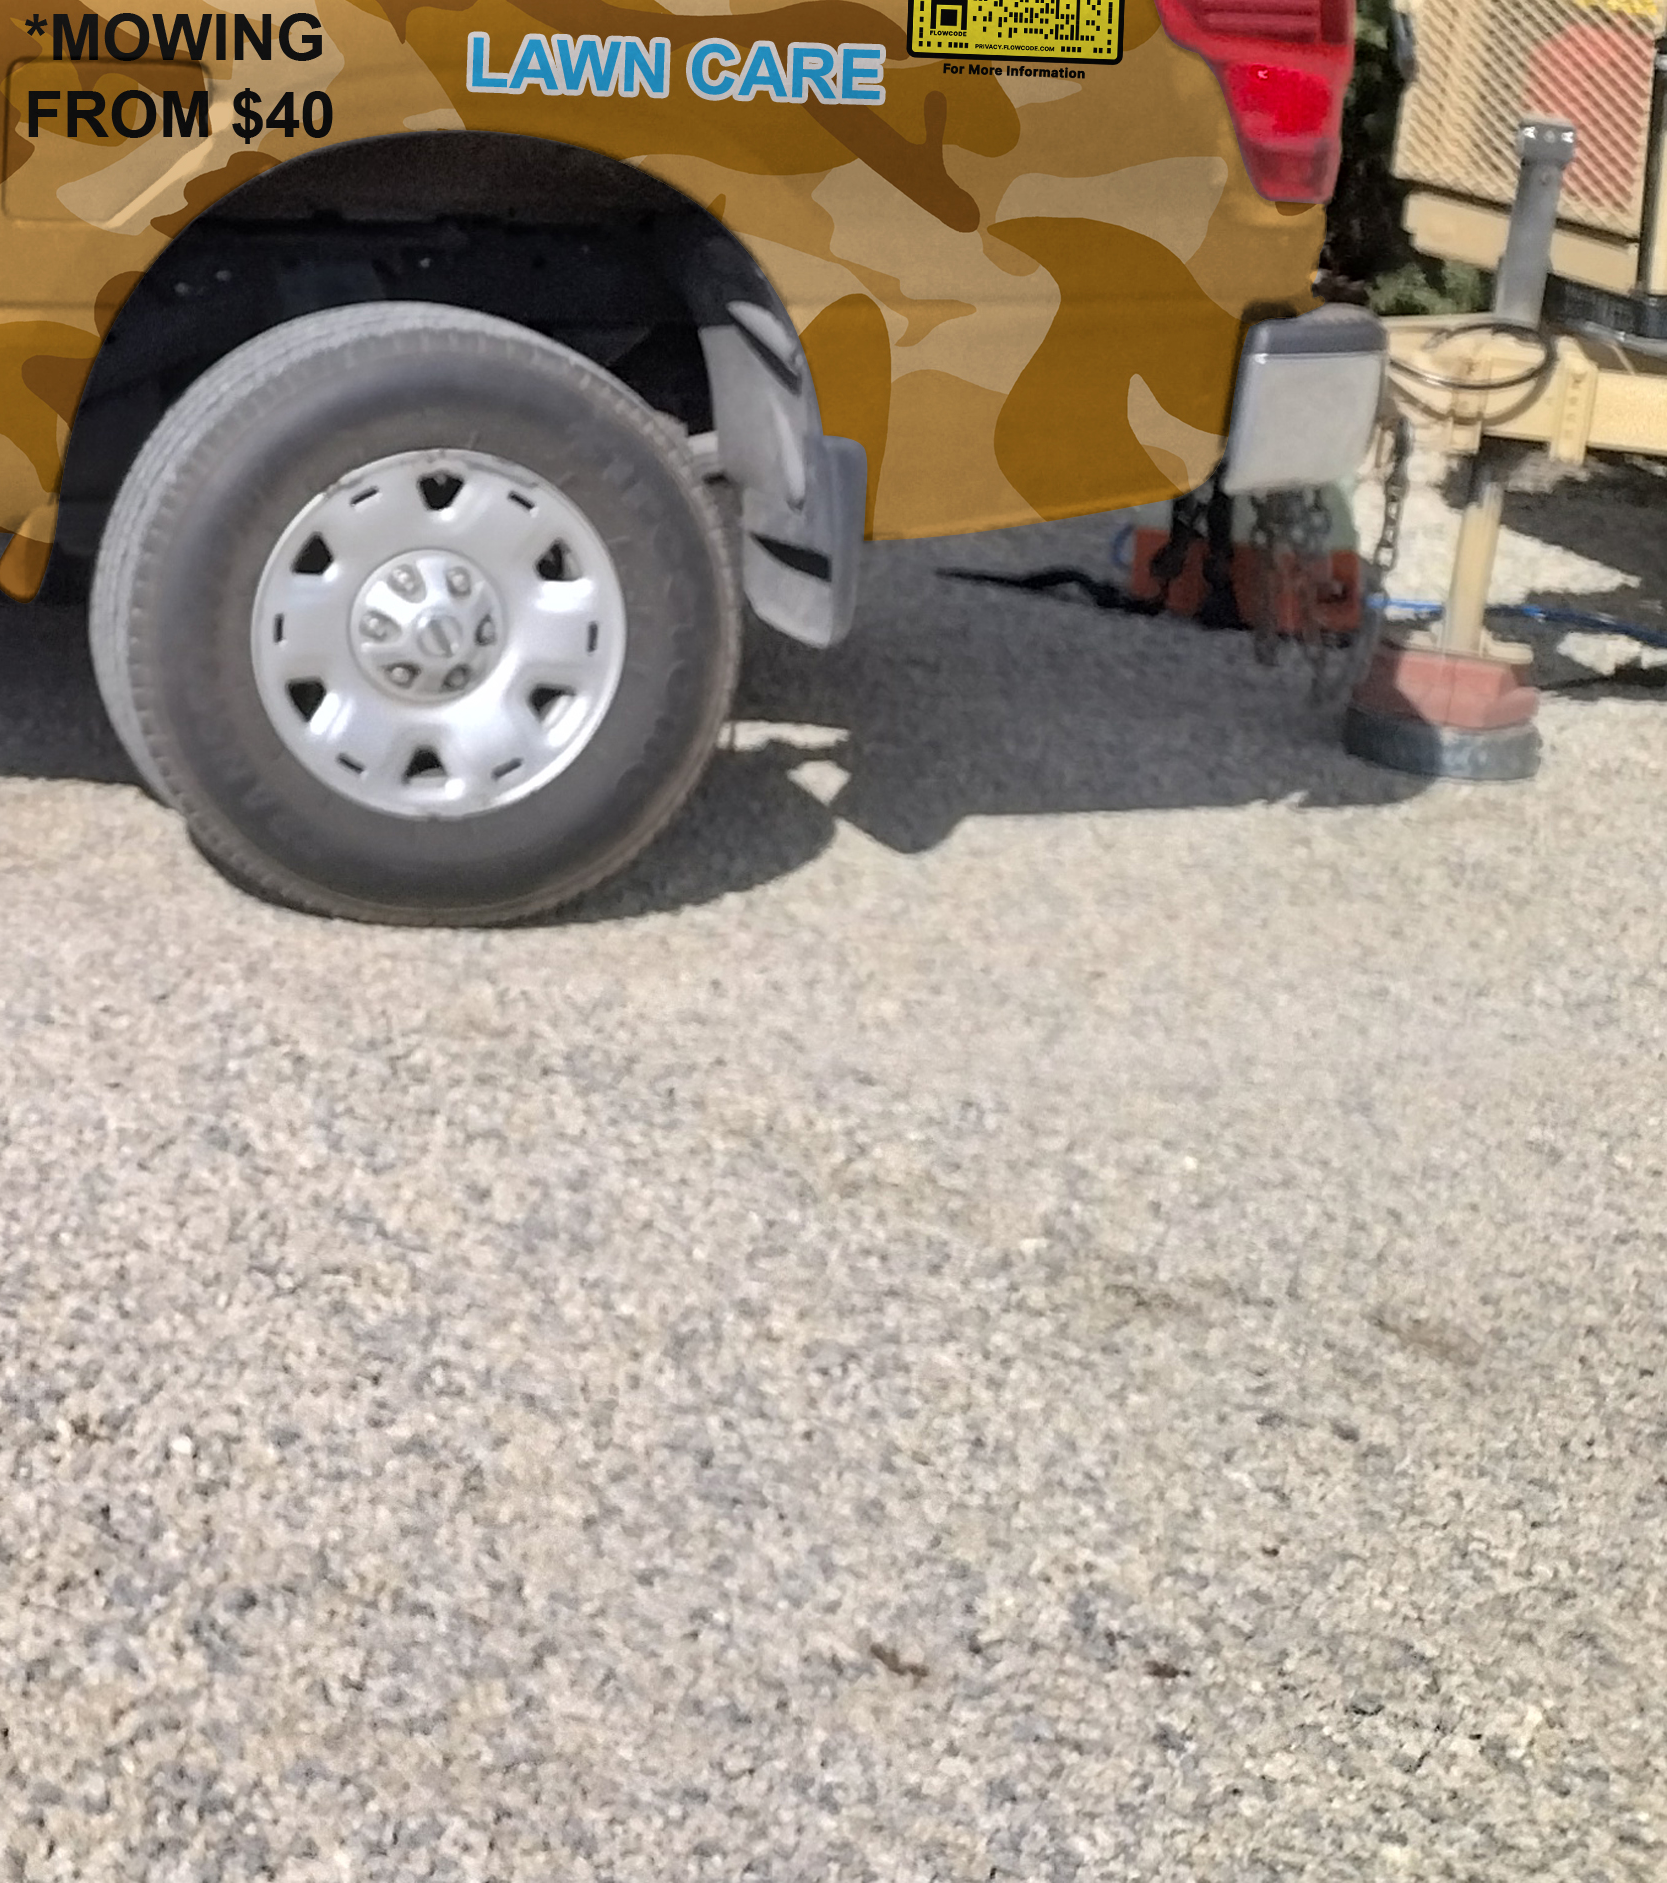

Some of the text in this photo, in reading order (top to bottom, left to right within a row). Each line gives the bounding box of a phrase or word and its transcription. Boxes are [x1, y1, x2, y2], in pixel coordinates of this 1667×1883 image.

[974, 43, 1055, 52] PRIVACY.FLOWCODE.COM
[467, 31, 886, 106] LAWN CARE
[943, 63, 1086, 79] For More Information
[28, 88, 334, 142] FROM $40
